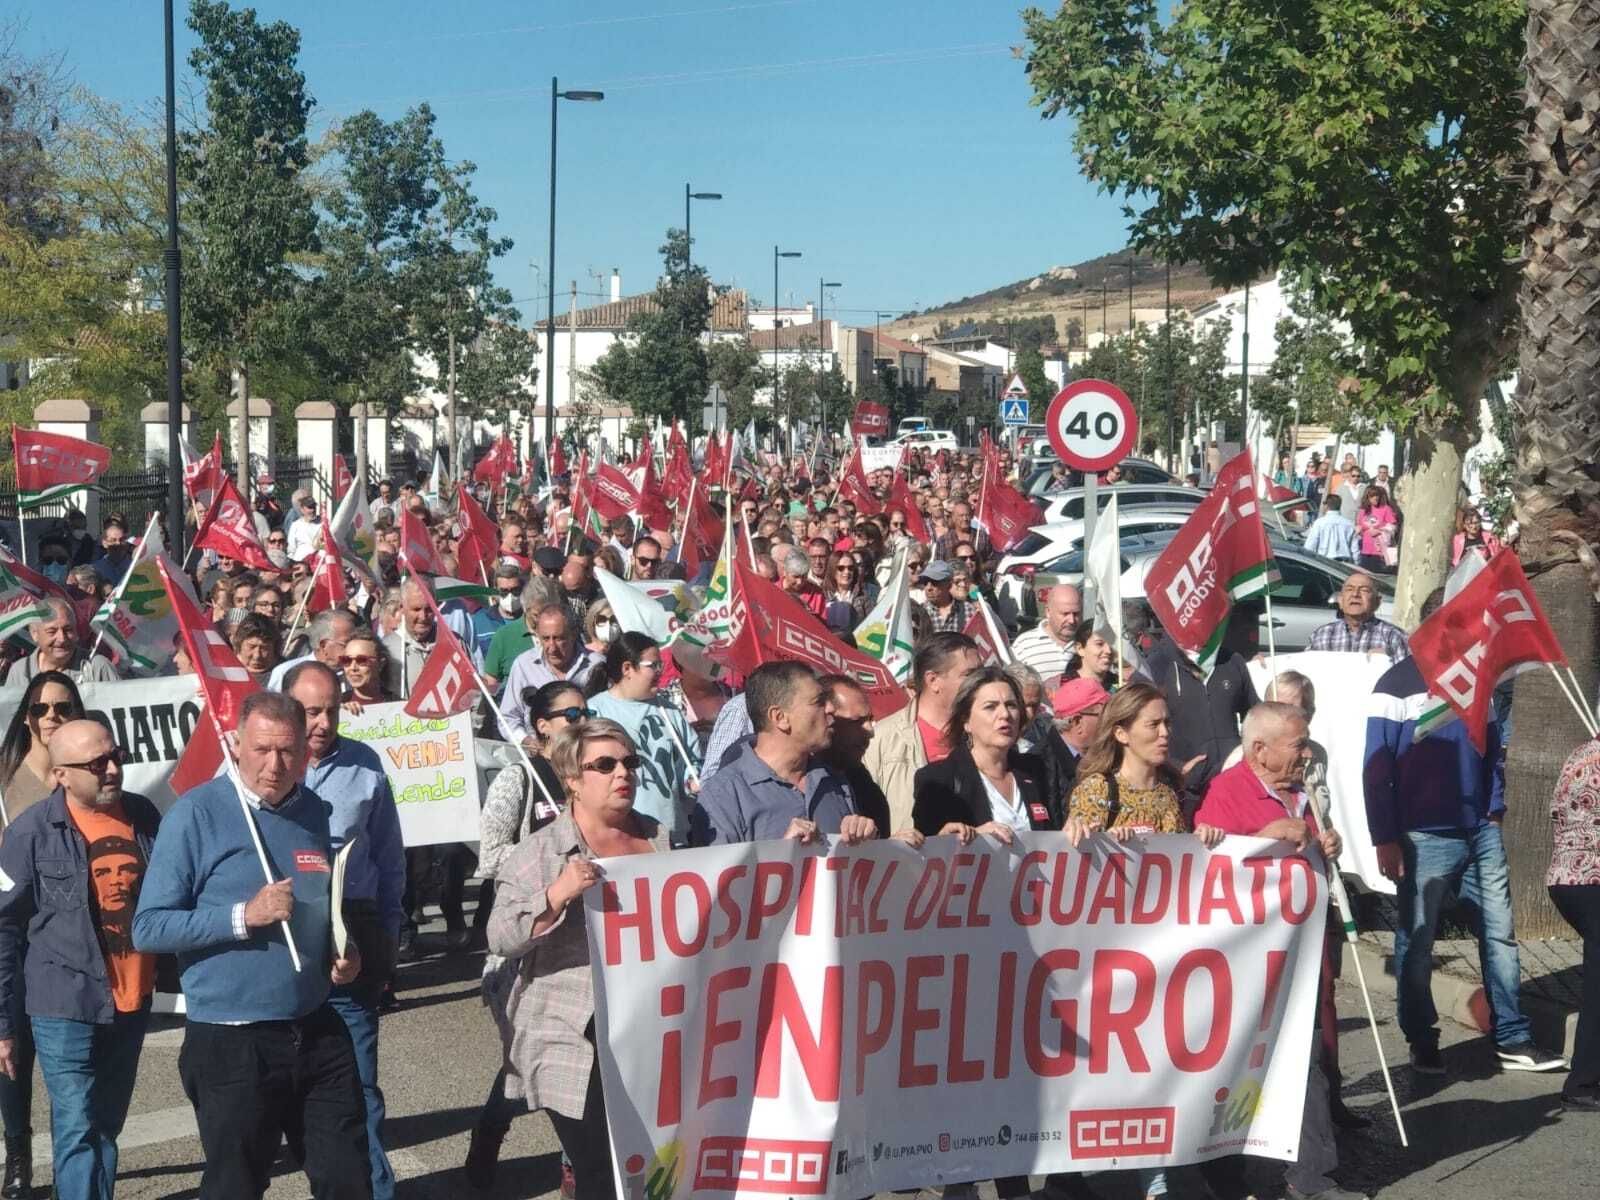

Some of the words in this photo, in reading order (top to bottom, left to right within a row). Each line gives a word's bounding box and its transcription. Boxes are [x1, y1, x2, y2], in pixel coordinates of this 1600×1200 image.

[1065, 411, 1118, 441] 40
[386, 731, 465, 770] VENDE
[602, 856, 898, 966] HOSPITAL
[904, 853, 991, 931] DEL
[1010, 851, 1318, 927] GUADIATO
[1077, 1118, 1167, 1148] CCOO
[701, 1148, 824, 1183] CCOO
